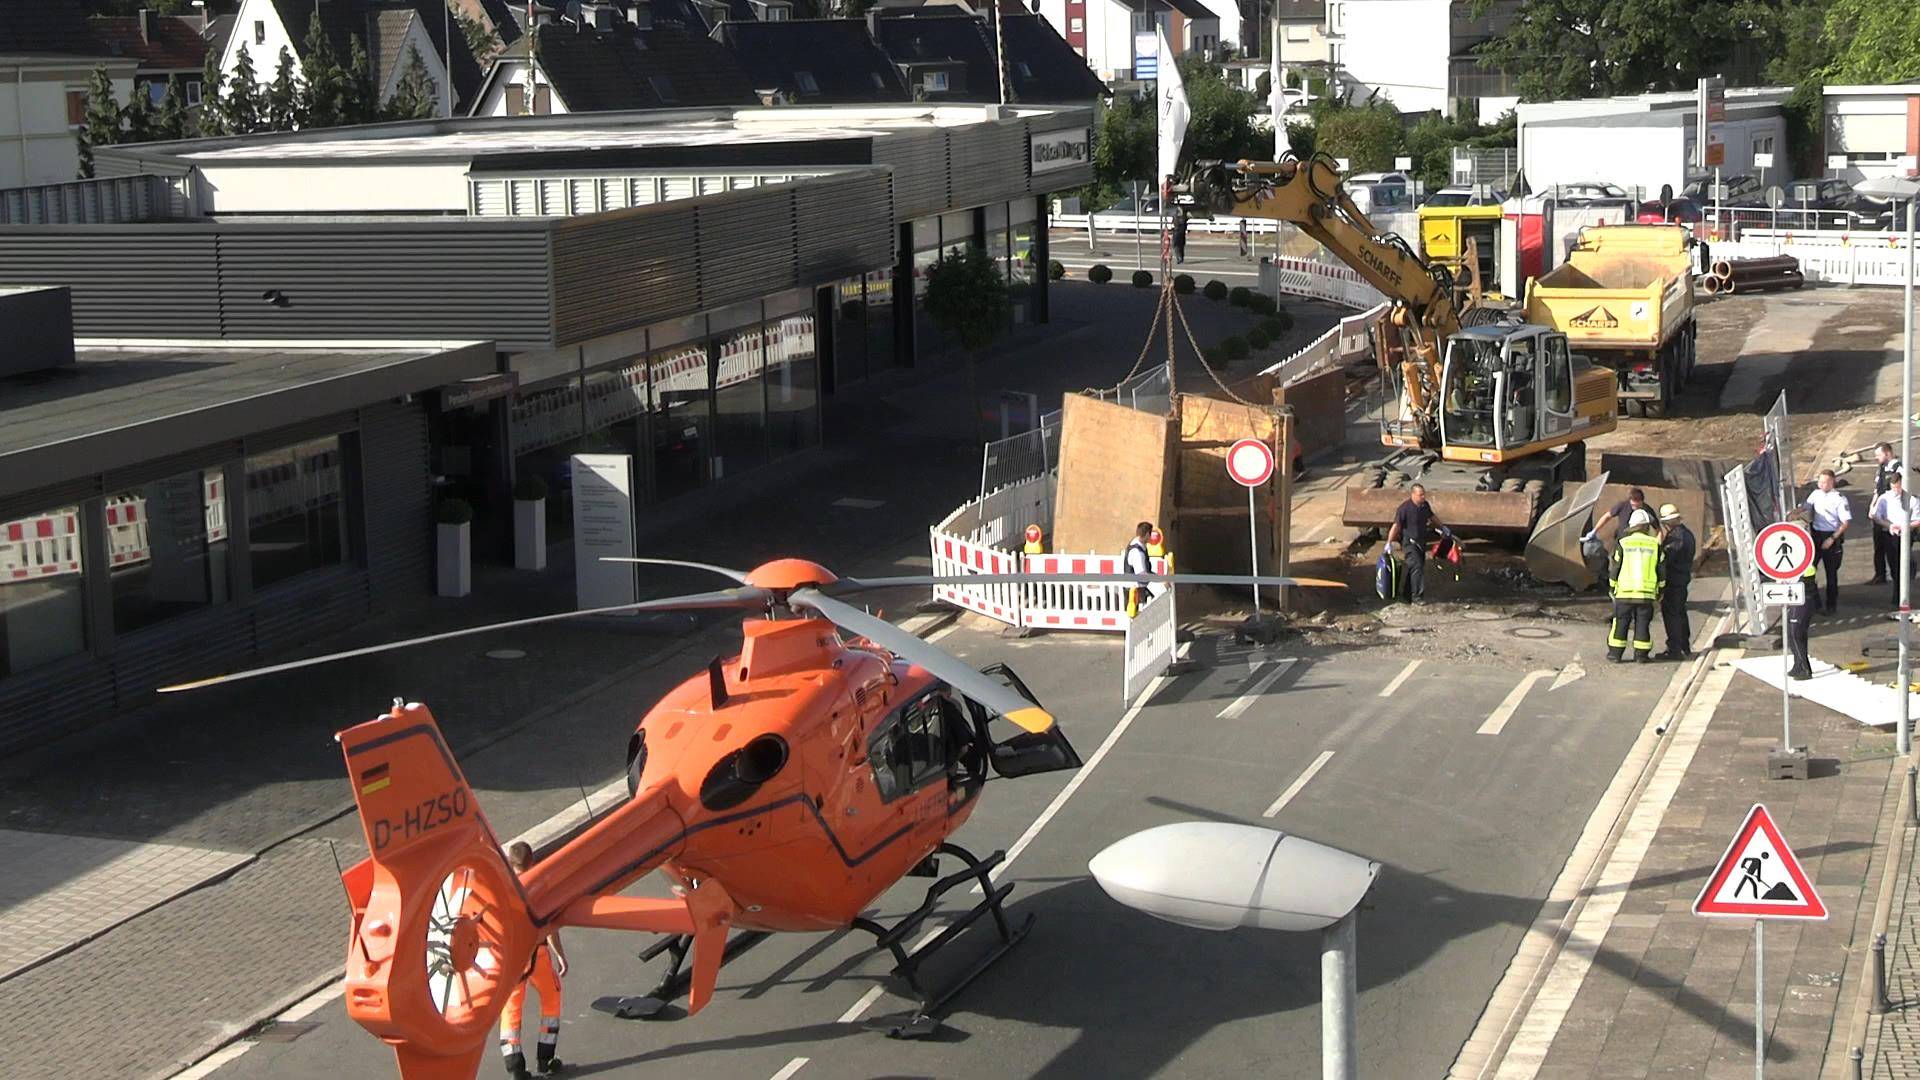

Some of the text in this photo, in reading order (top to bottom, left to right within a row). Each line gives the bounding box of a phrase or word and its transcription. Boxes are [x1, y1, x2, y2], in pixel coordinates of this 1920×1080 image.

[1358, 245, 1402, 286] SCHARFF
[1569, 319, 1618, 328] SCHARFF
[374, 787, 466, 849] D-HZSO
